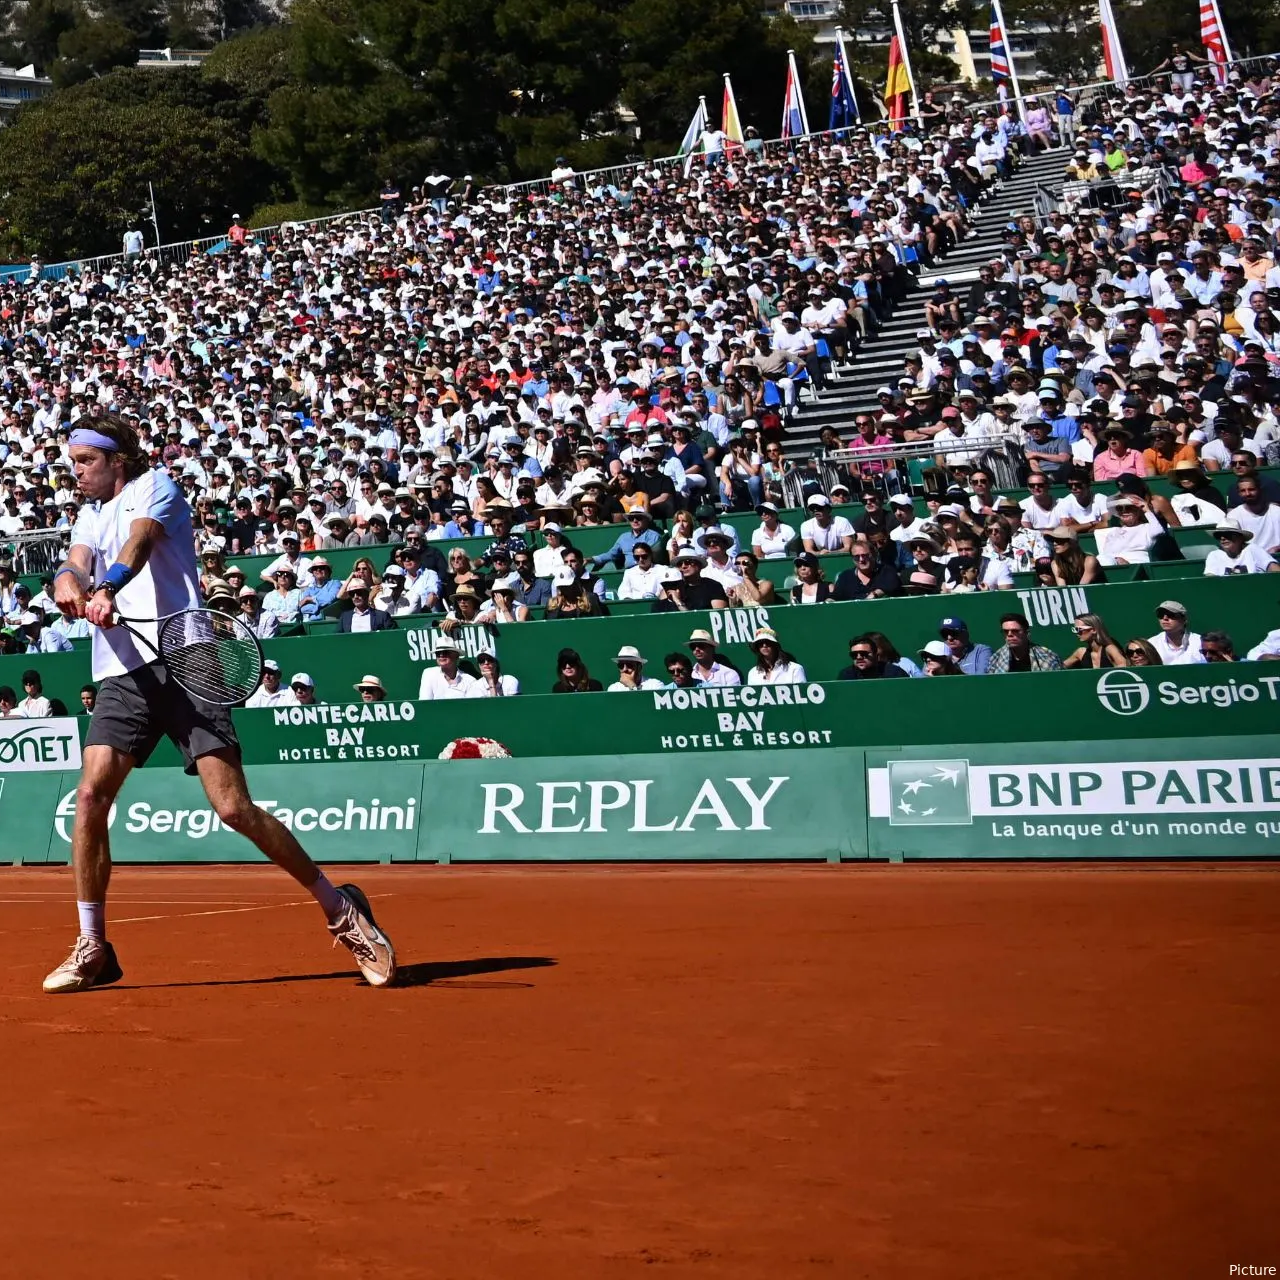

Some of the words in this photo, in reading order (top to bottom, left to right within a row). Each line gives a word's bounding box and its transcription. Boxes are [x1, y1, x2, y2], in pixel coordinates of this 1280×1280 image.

[1016, 587, 1089, 627] TURIN
[709, 608, 771, 644] PARIS
[1158, 678, 1260, 707] Sergio
[717, 711, 765, 733] BAY
[326, 727, 365, 747] BAY
[661, 734, 724, 749] HOTEL
[733, 733, 744, 747] &
[752, 730, 832, 746] RESORT
[279, 747, 331, 761] HOTEL
[338, 746, 347, 759] &
[355, 744, 420, 759] RESORT
[989, 771, 1102, 807] BNP
[125, 800, 240, 839] Sergi
[477, 775, 790, 835] REPLAY
[992, 822, 1016, 838] La
[1023, 821, 1102, 840] banque
[1111, 820, 1159, 836] d'un
[1168, 819, 1246, 835] monde
